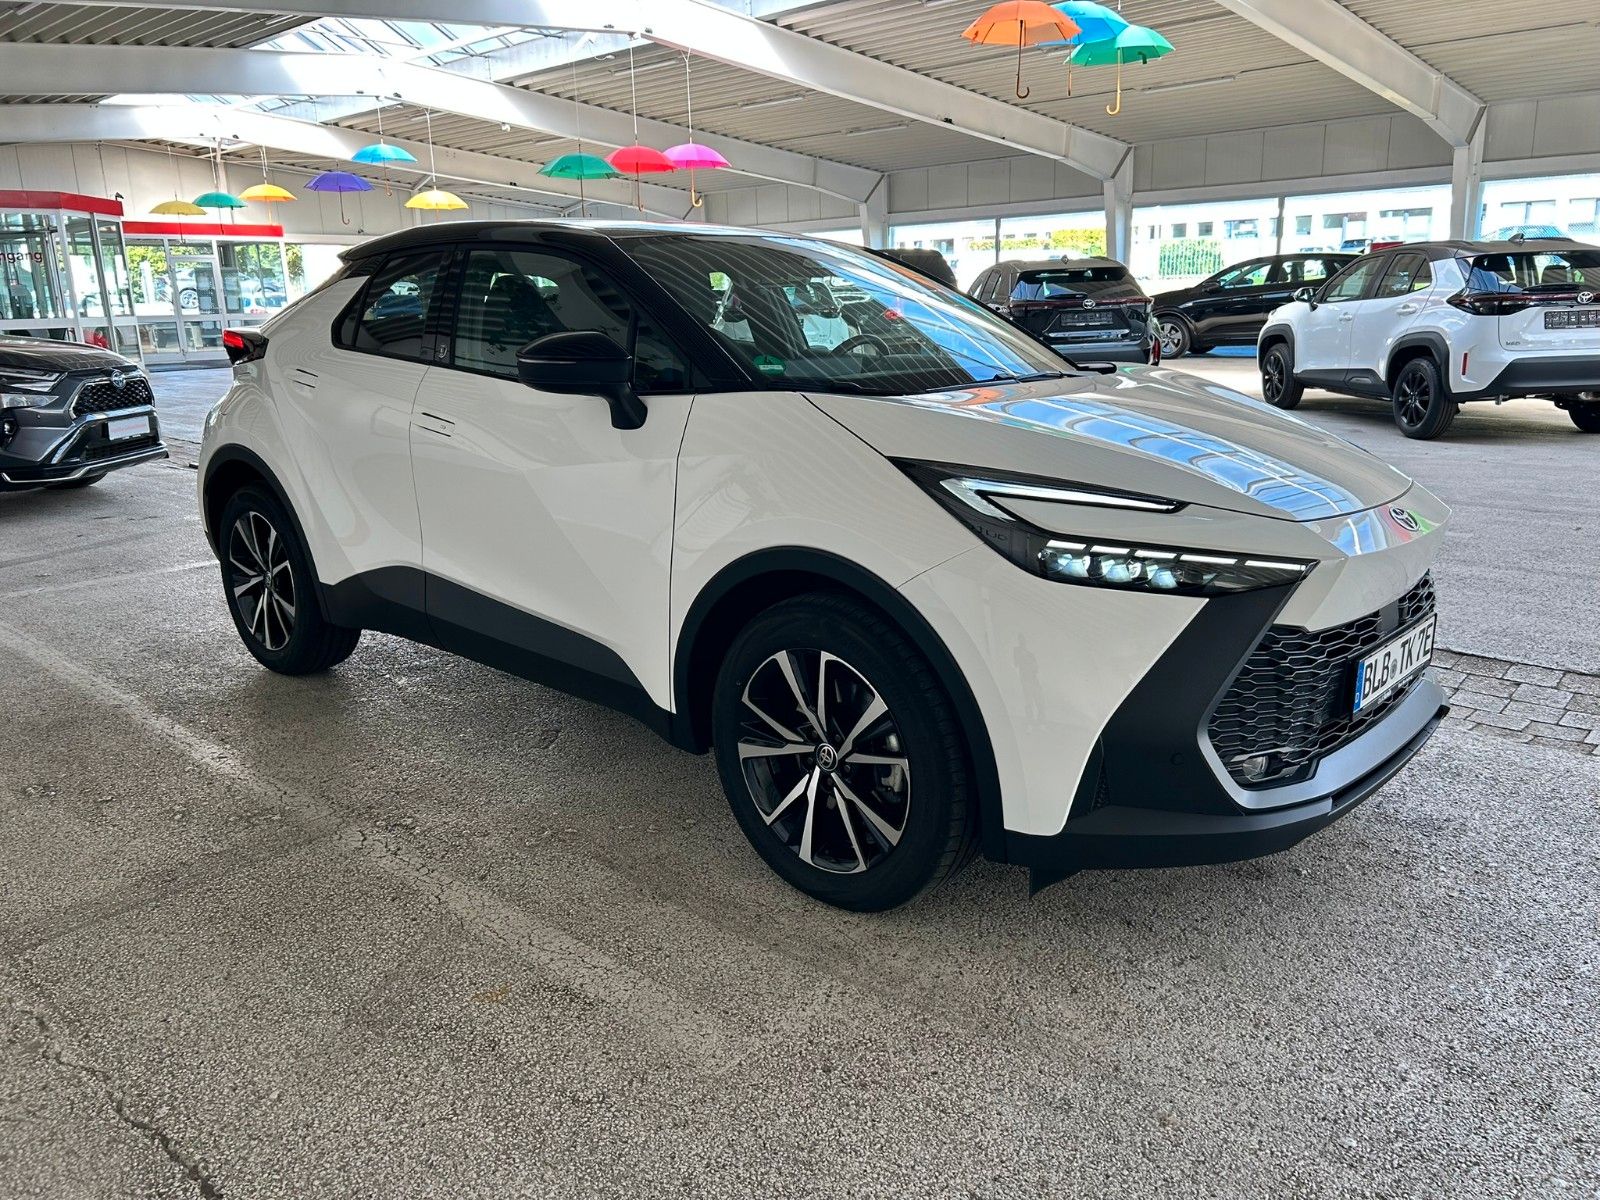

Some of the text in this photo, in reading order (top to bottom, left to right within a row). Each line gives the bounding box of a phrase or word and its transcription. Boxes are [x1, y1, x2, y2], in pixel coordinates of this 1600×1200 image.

[1362, 622, 1434, 701] BLB TK 7E
